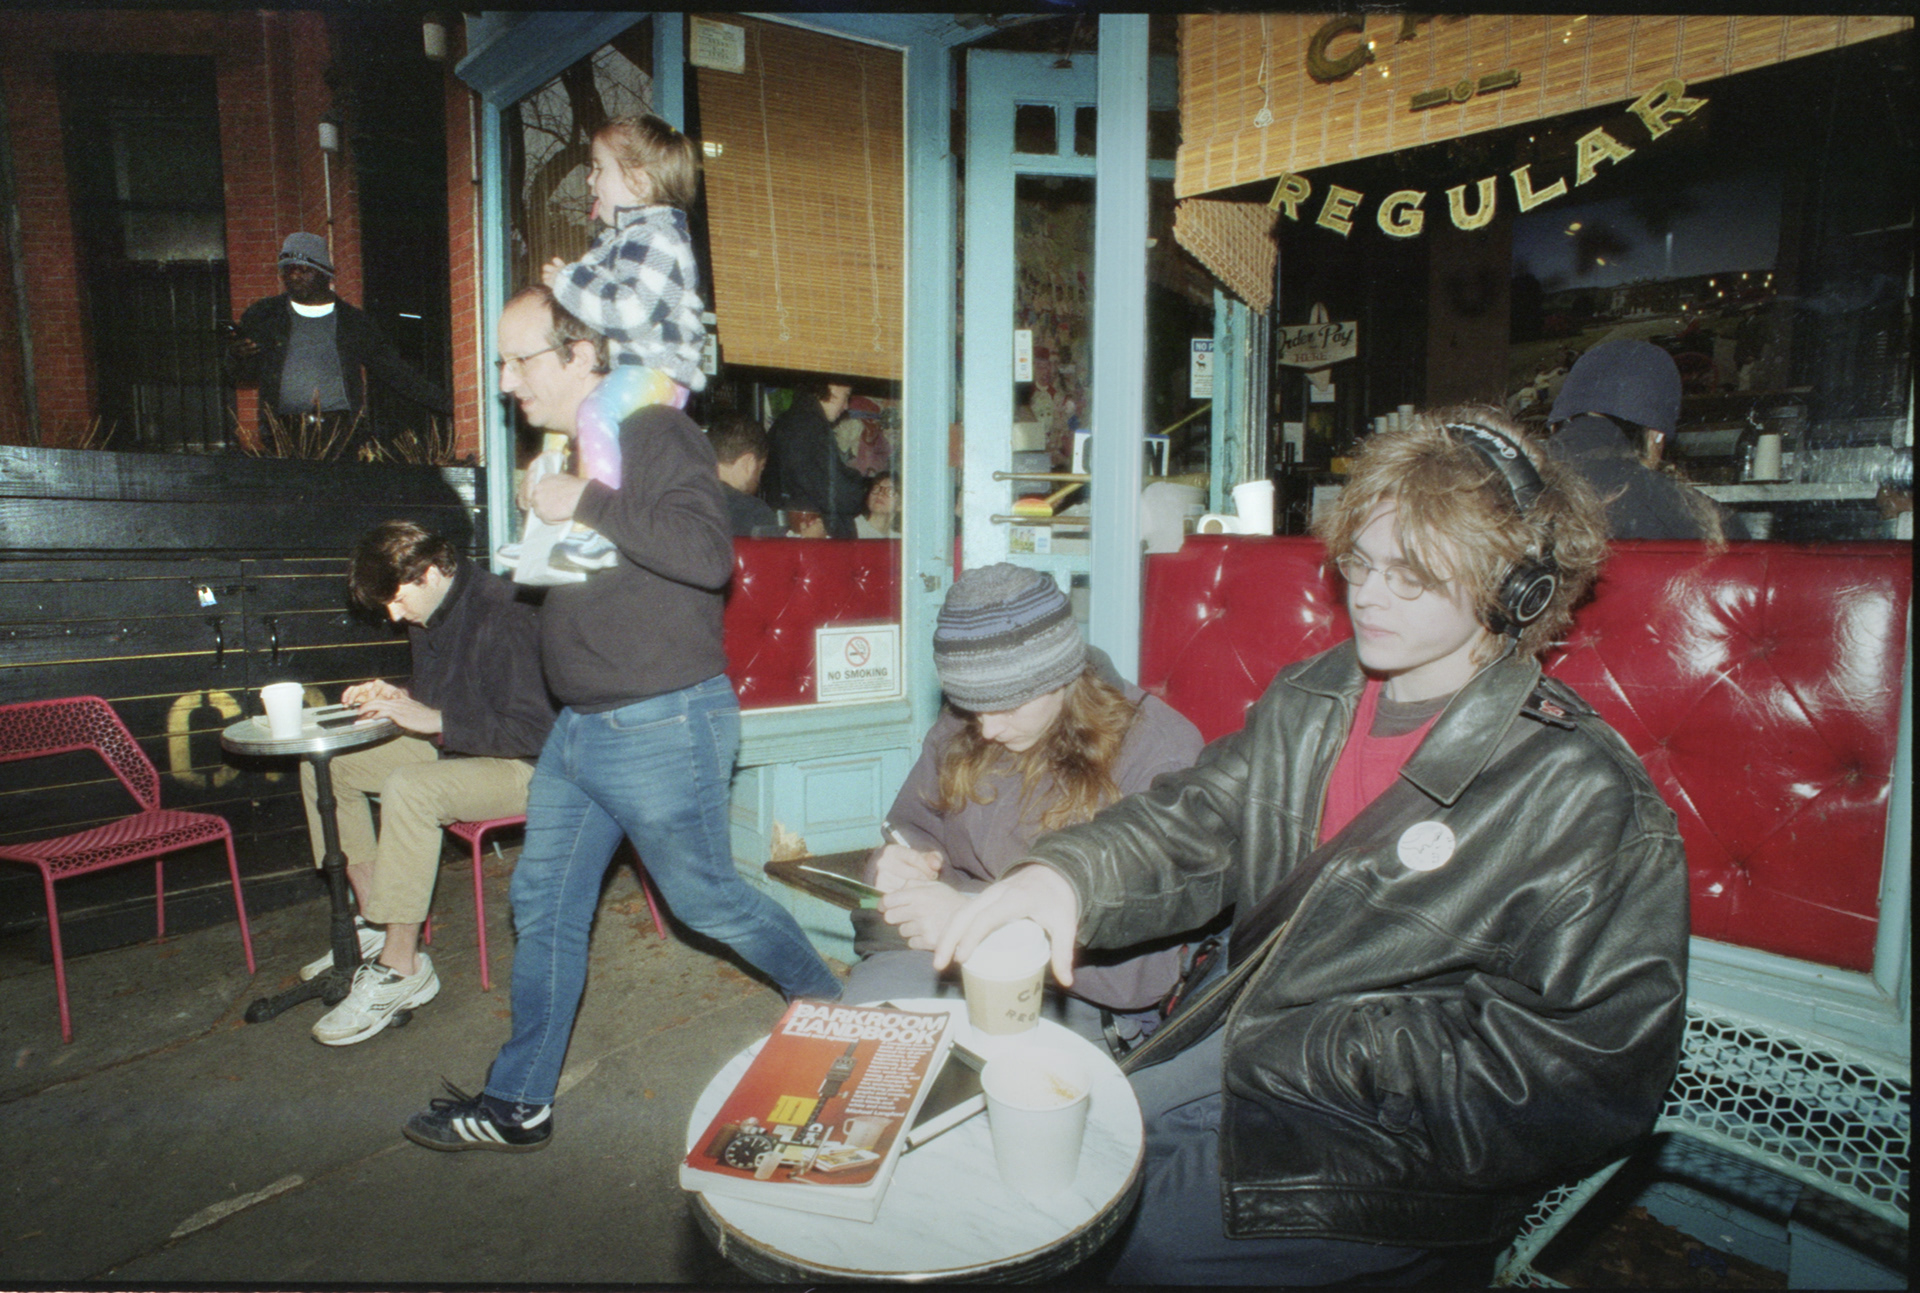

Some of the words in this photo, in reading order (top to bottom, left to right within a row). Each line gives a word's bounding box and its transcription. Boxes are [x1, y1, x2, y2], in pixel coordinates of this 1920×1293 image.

[1268, 79, 1709, 237] REGULAR
[1195, 342, 1207, 351] NO
[1318, 323, 1354, 349] Pay
[827, 671, 842, 681] NO
[844, 667, 888, 680] SMOKING
[784, 1017, 938, 1044] HANDBOOK
[794, 1004, 948, 1031] DARKROOM
